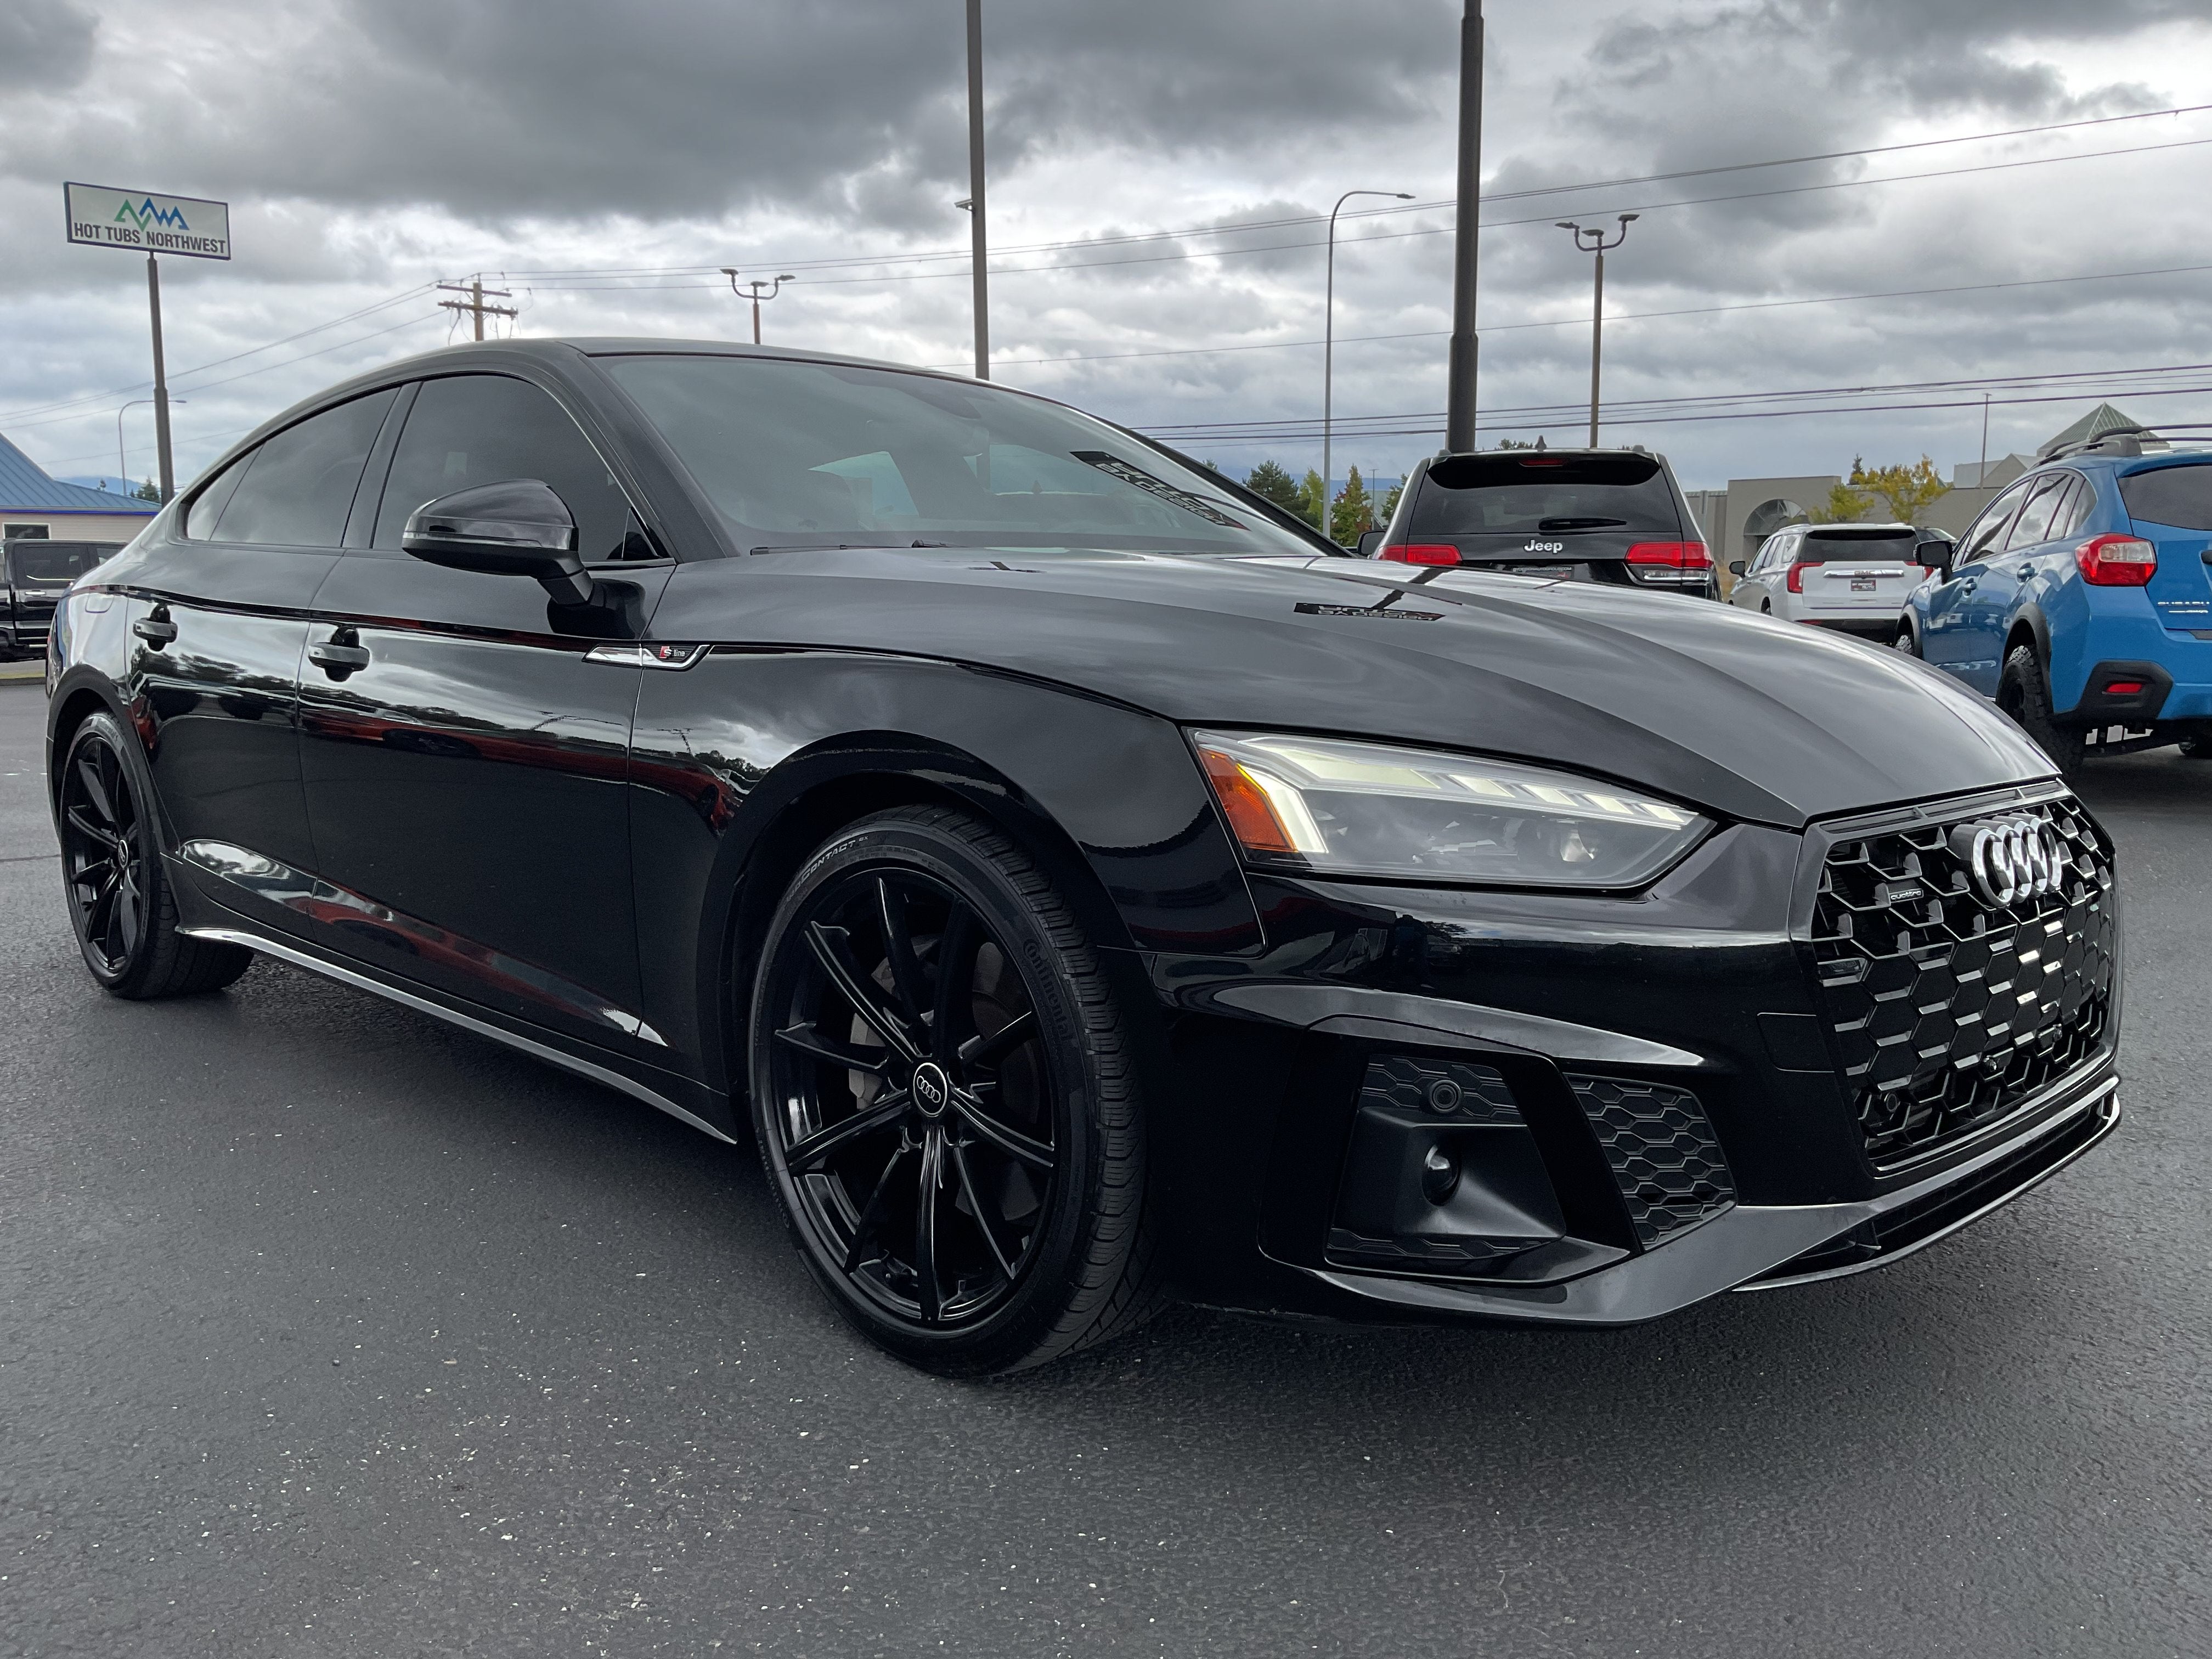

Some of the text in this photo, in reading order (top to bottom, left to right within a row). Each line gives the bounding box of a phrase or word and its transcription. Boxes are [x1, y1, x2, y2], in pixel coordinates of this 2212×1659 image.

[74, 222, 225, 253] HOT TUBS NORTHWEST
[1524, 539, 1563, 554] Jeep
[1891, 890, 1921, 900] quattro
